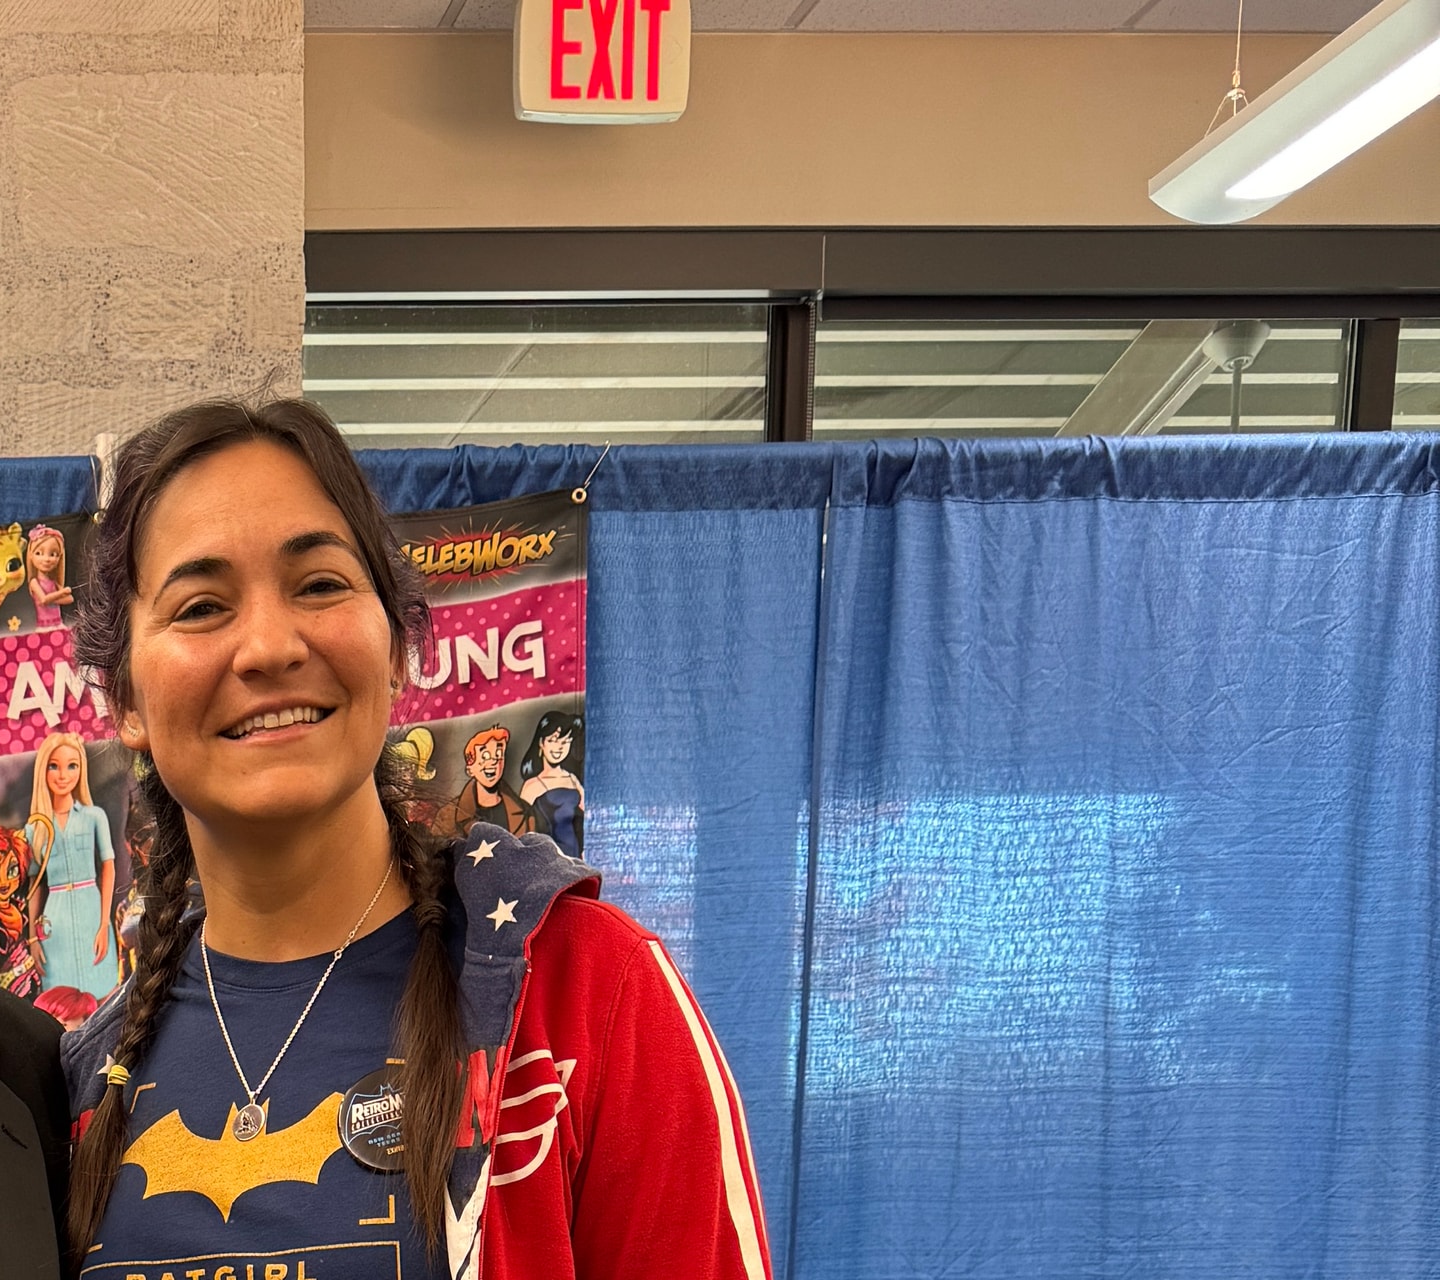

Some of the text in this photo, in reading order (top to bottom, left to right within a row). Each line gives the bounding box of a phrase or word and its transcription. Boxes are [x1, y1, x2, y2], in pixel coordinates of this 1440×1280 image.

[550, 0, 670, 101] EXIT
[401, 530, 557, 577] ELEBWORX
[408, 620, 546, 689] UNG
